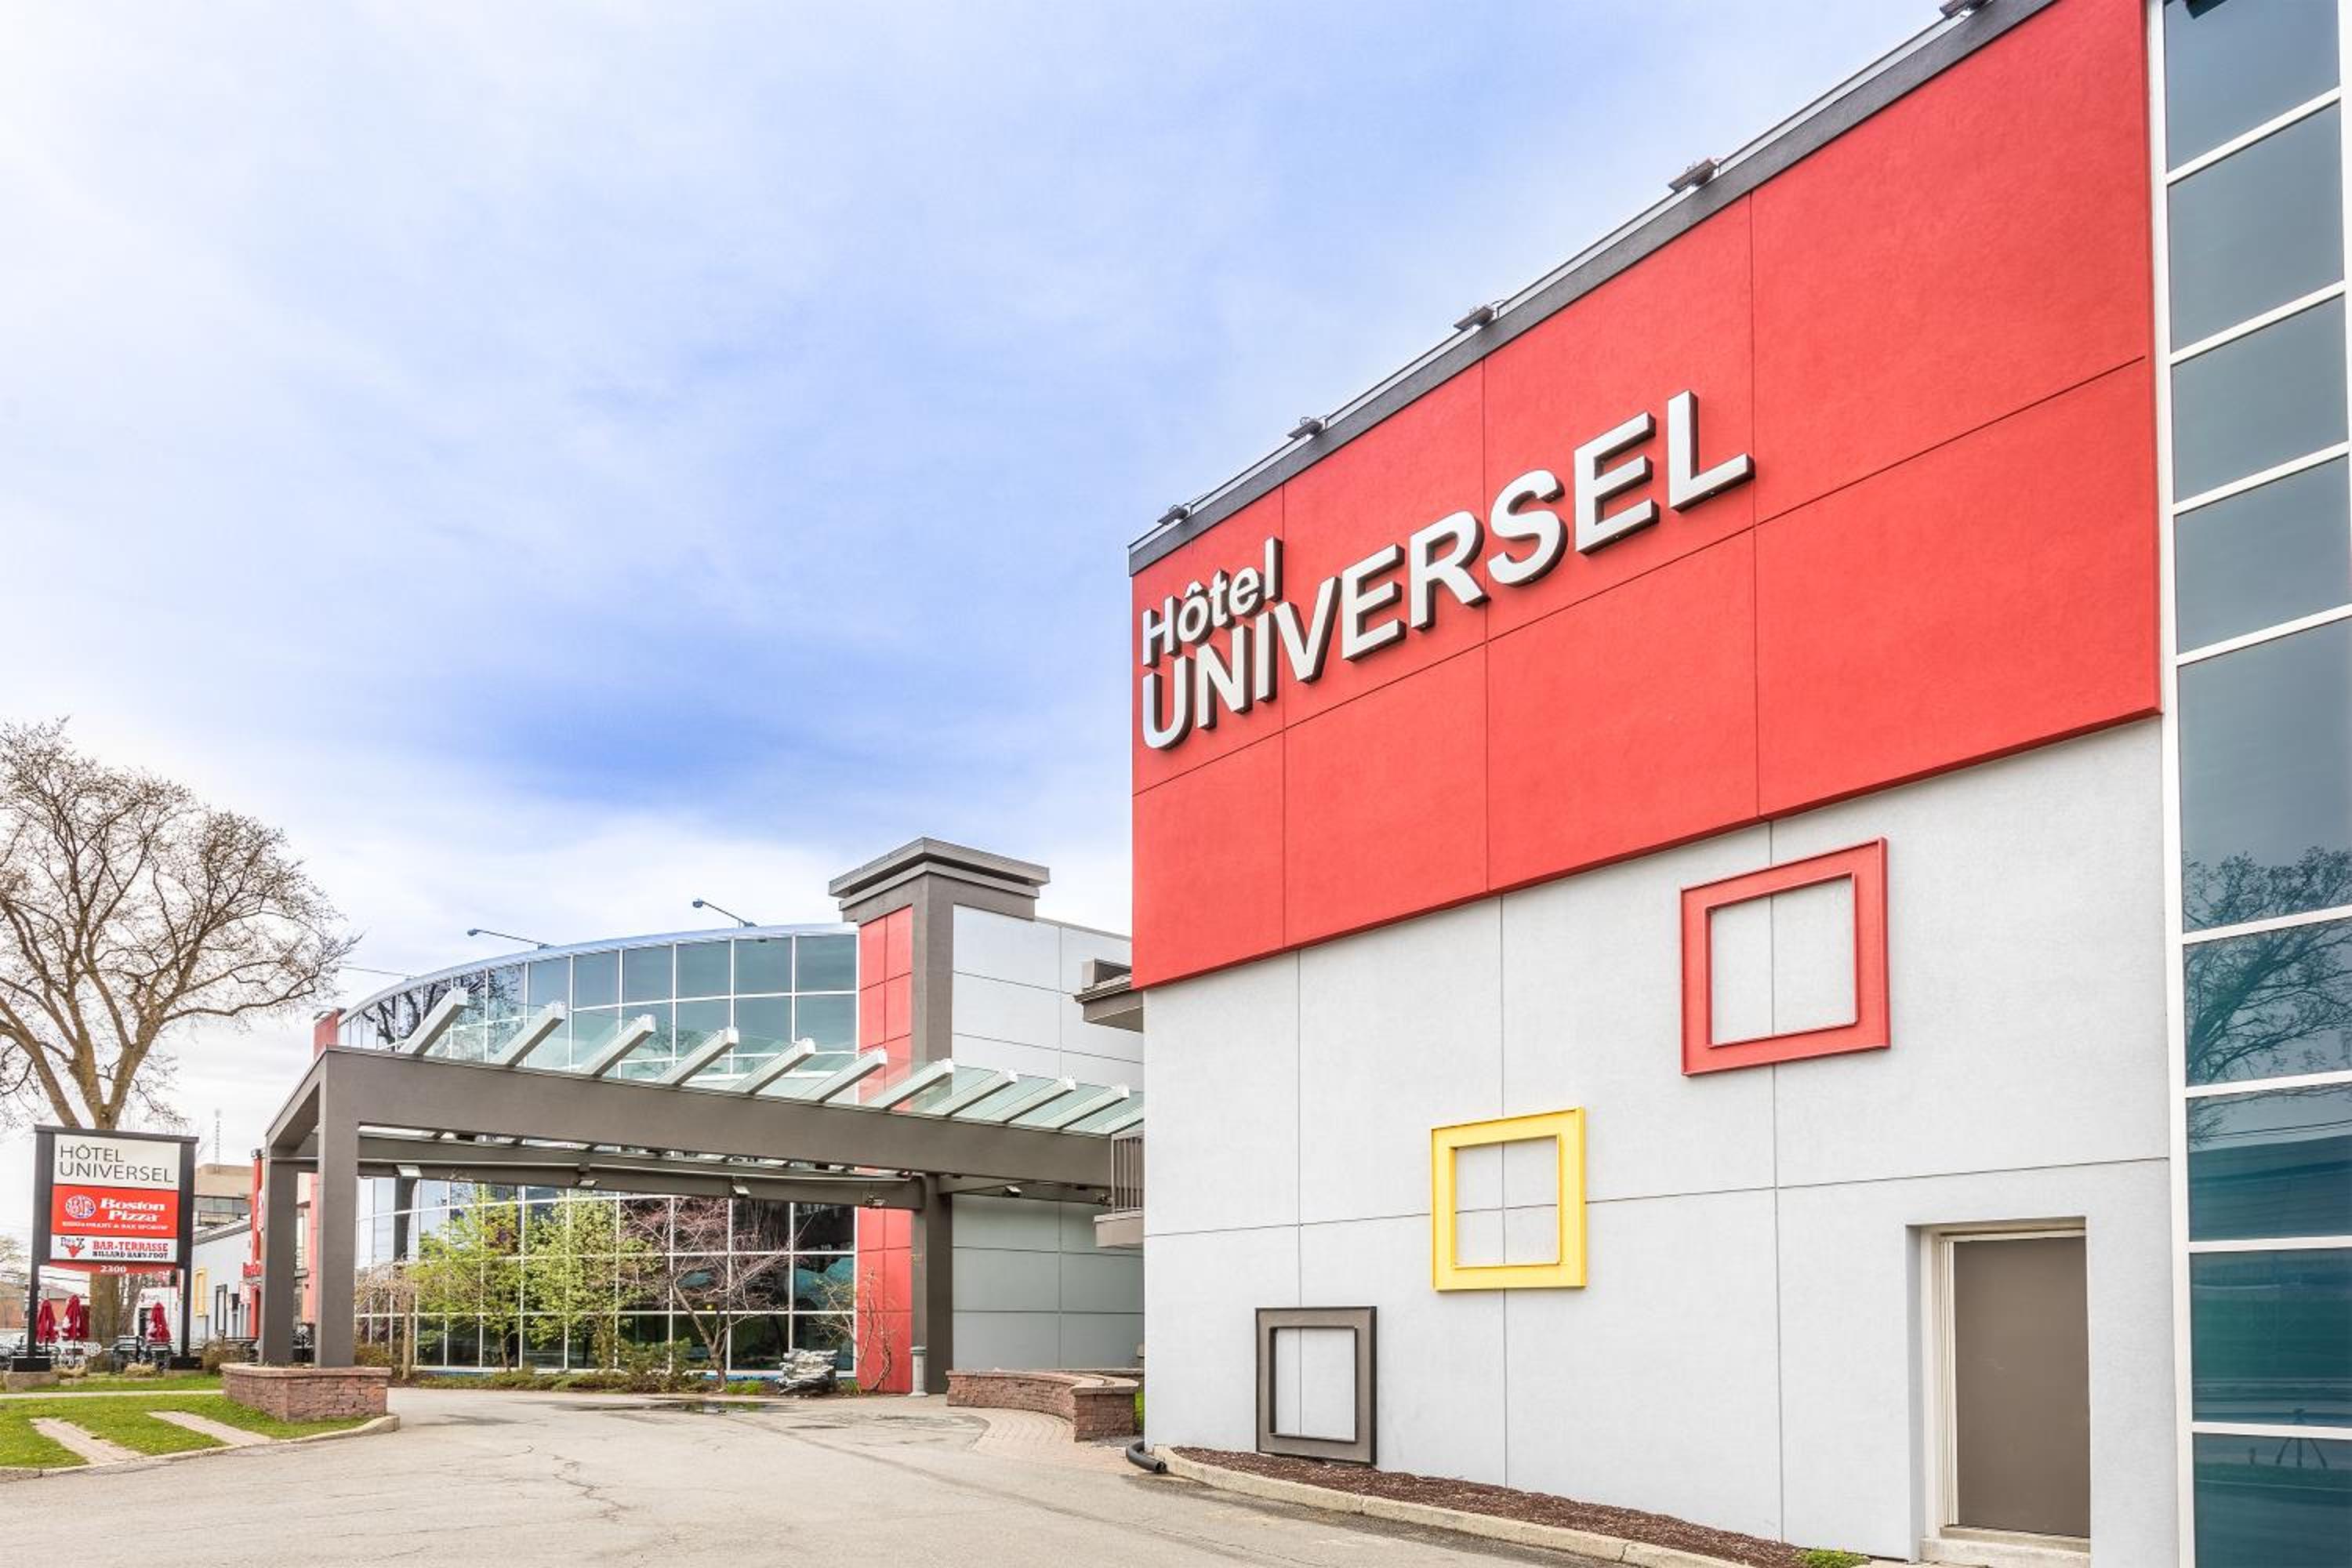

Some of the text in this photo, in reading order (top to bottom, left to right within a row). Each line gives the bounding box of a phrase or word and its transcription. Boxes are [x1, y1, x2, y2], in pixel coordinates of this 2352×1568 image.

[1142, 389, 1755, 750] UNIVERSEL
[1141, 535, 1284, 668] Hôtel
[60, 1144, 125, 1163] HÔTEL
[59, 1161, 174, 1183] UNIVERSEL
[100, 1197, 165, 1211] Boston
[108, 1210, 158, 1222] Pizza
